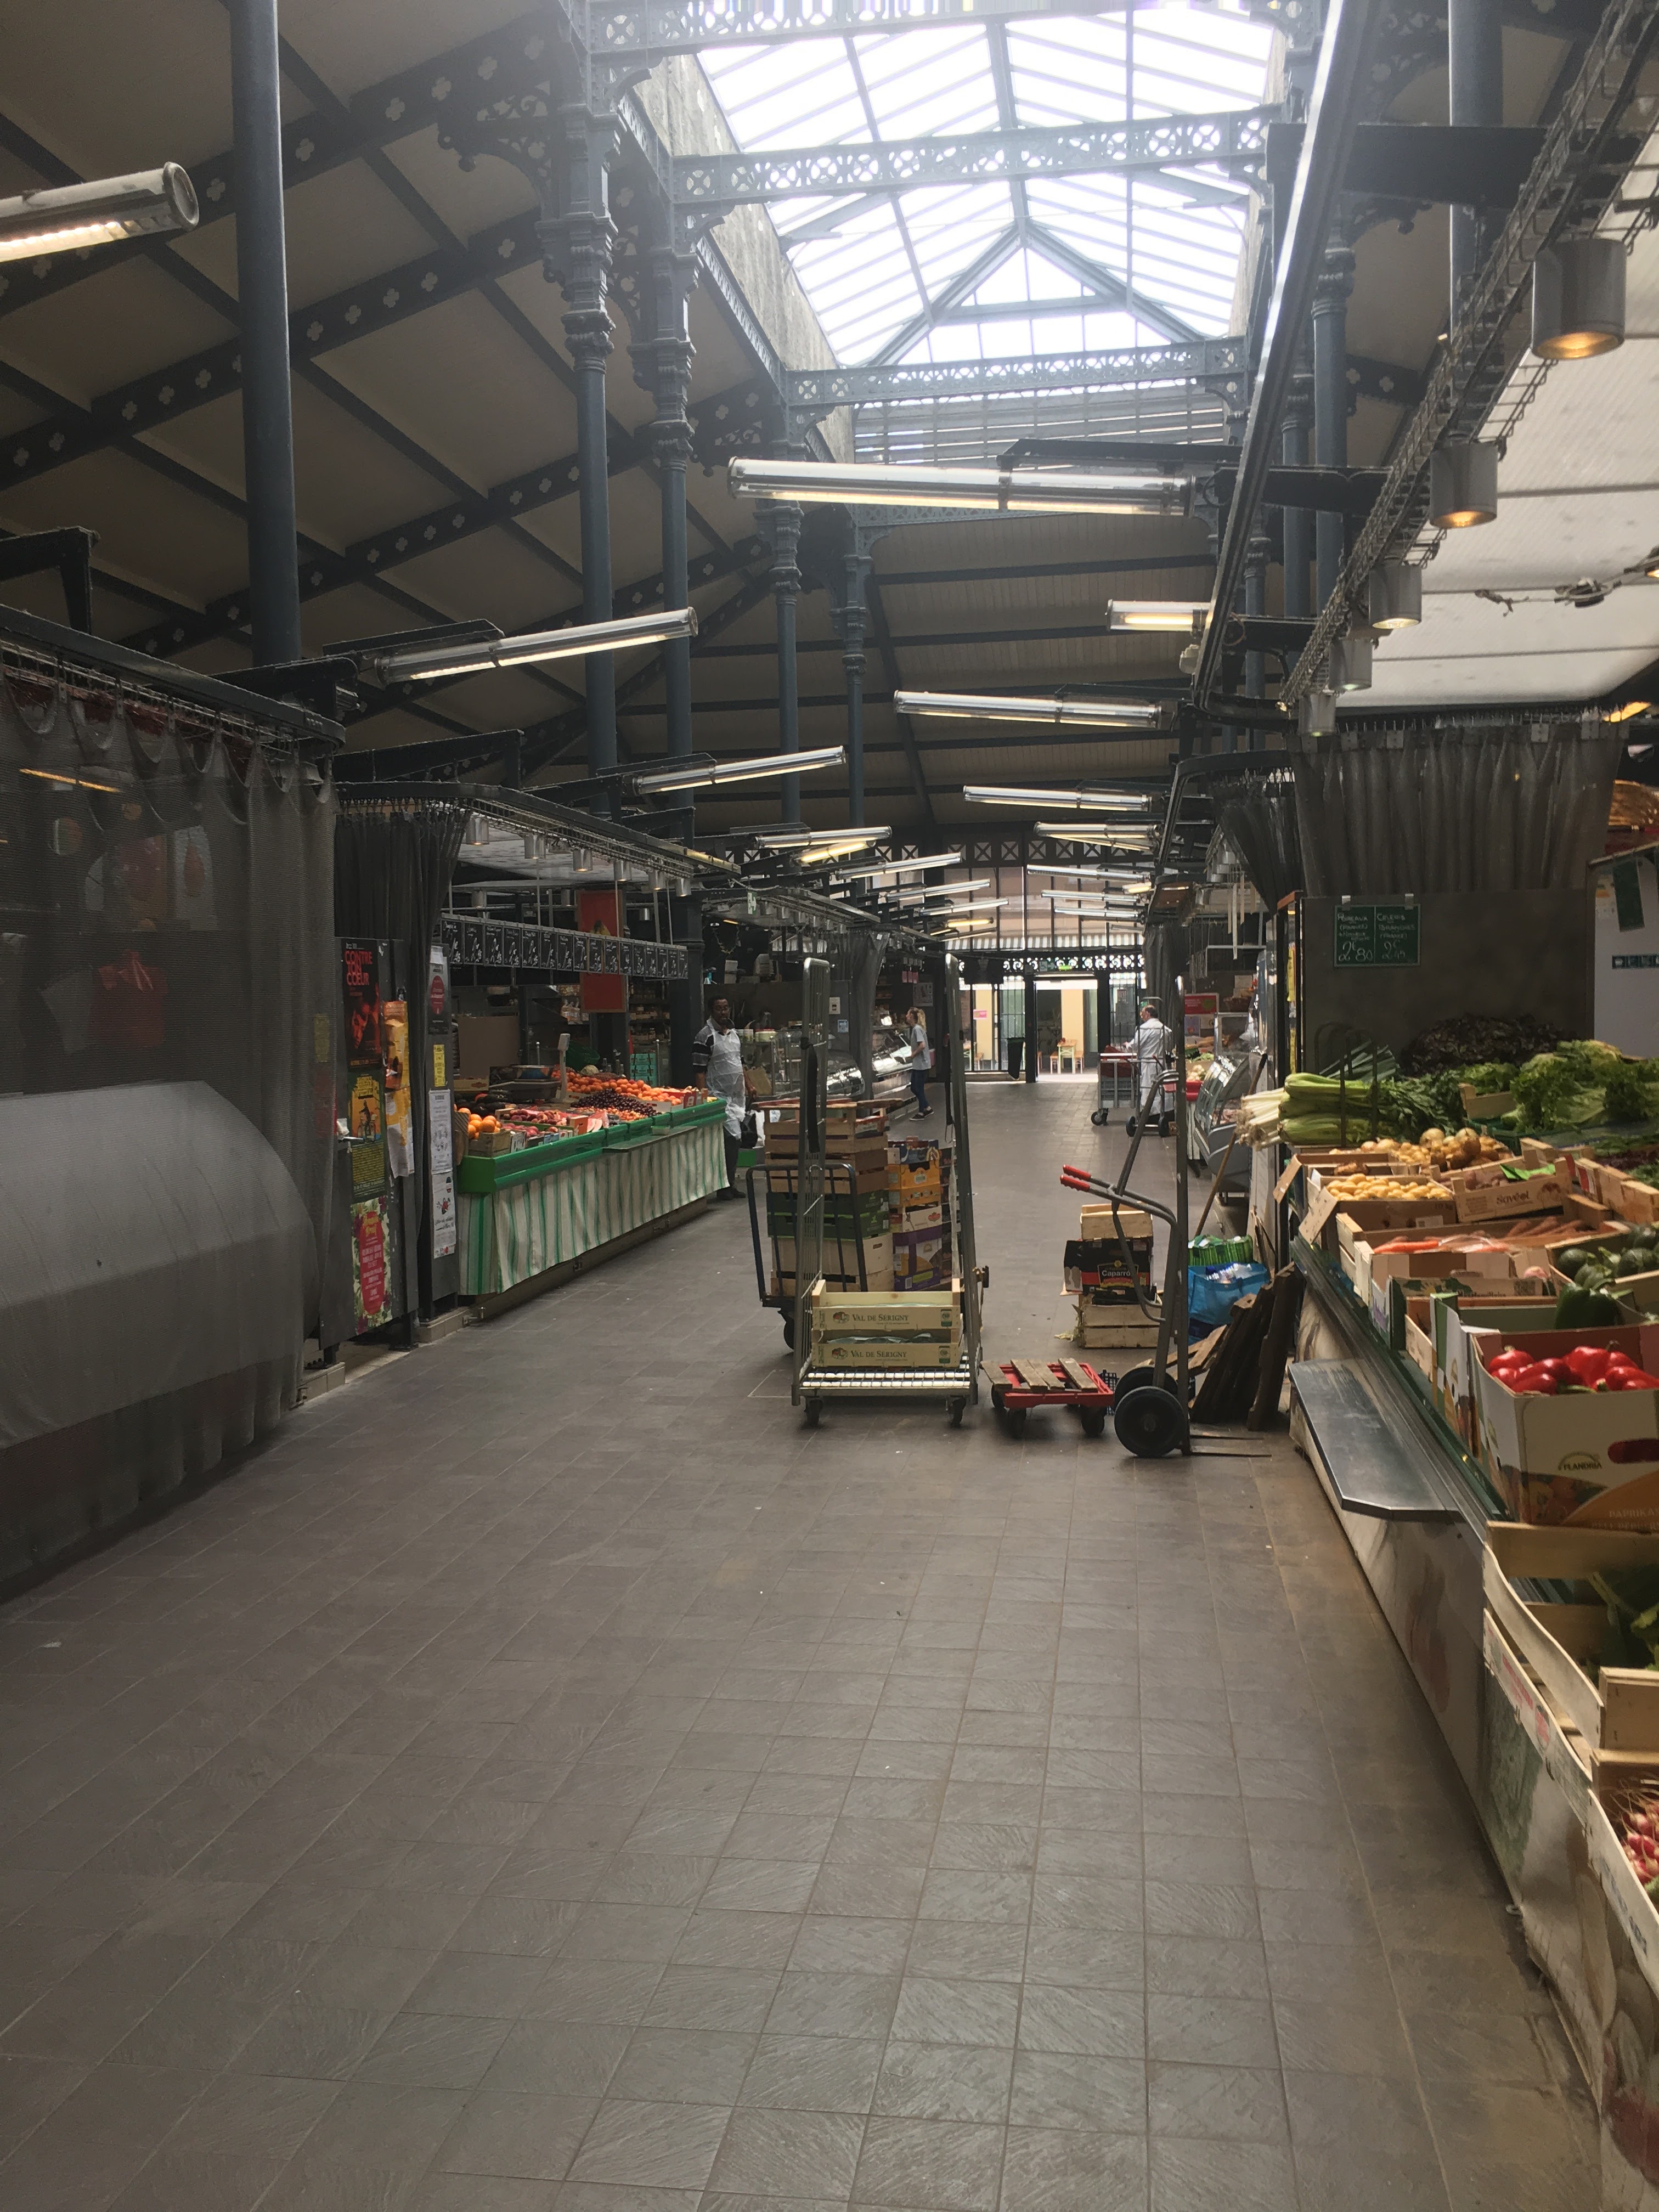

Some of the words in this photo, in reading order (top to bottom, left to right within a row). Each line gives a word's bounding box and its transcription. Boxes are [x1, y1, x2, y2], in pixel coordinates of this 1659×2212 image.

[345, 950, 373, 964] CONTRE
[347, 962, 362, 975] TON
[1564, 1462, 1602, 1470] FLANDRIA
